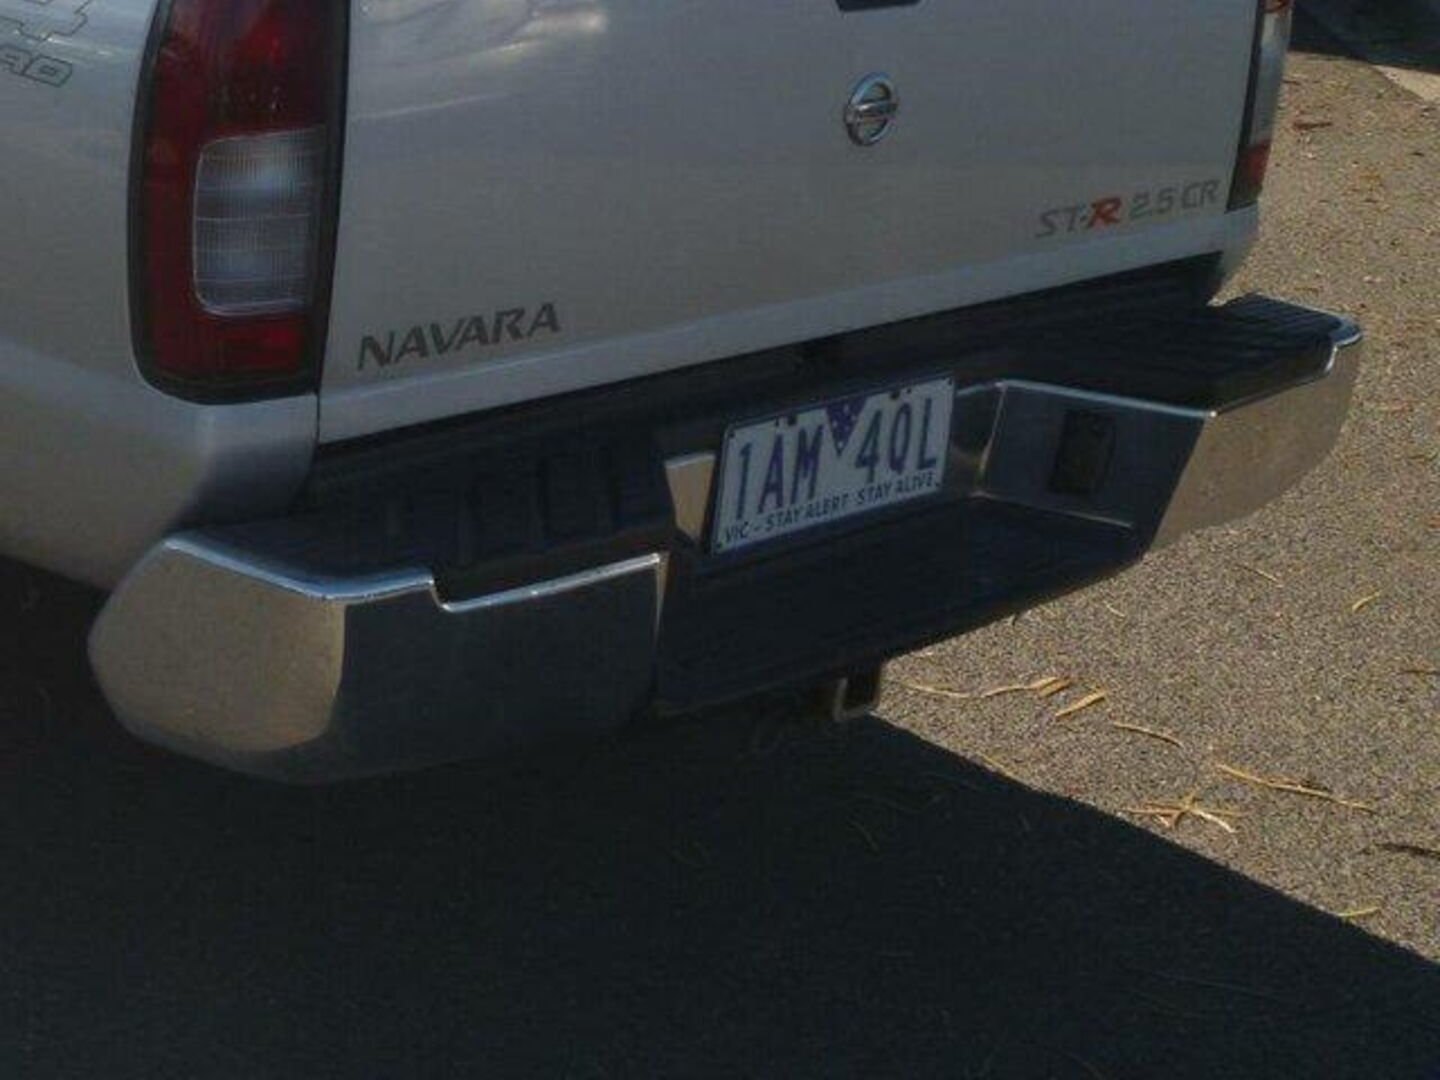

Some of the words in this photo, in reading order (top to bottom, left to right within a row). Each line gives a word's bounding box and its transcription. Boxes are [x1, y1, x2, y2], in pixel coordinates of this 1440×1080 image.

[358, 302, 561, 370] NAVARA
[735, 423, 824, 520] 1AM
[766, 506, 802, 531] STAY
[806, 493, 848, 518] ALERT
[857, 482, 892, 506] STAY
[895, 472, 936, 493] ALIVE
